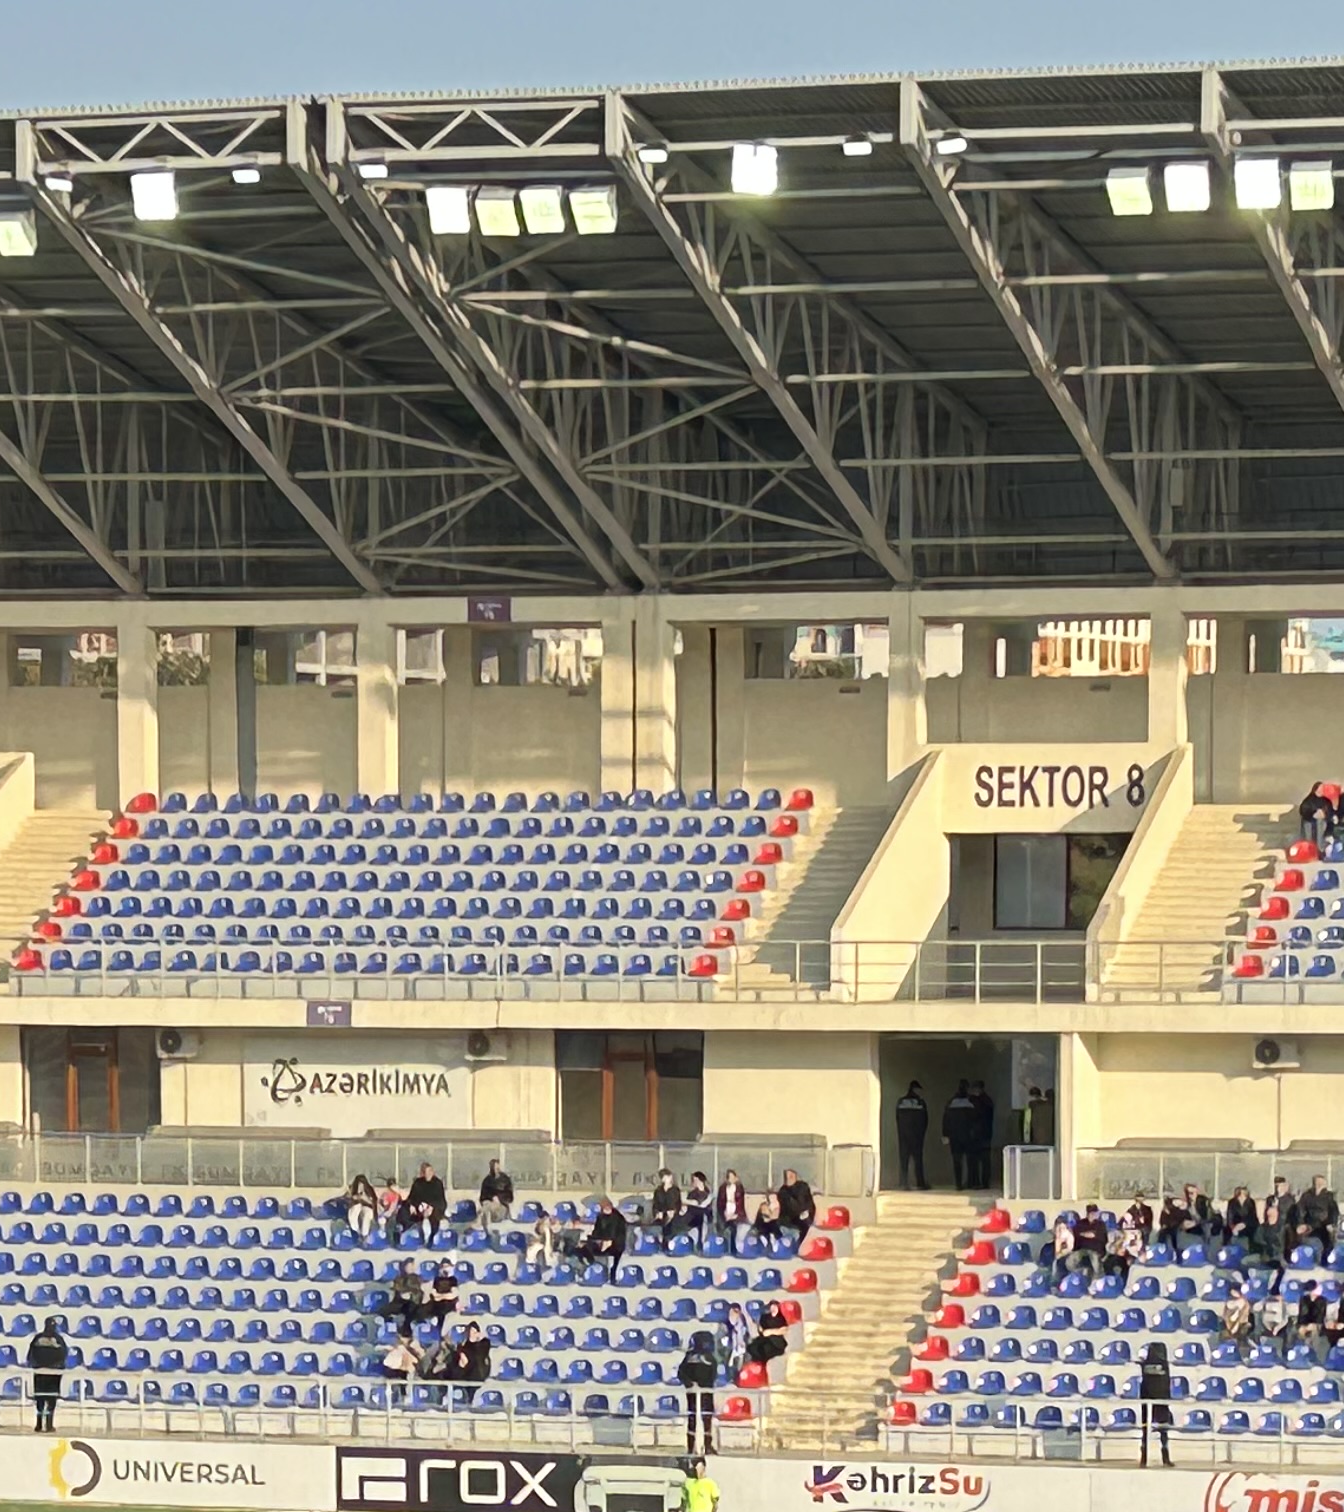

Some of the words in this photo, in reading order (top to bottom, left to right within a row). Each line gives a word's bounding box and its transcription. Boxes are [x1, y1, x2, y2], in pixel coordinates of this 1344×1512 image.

[974, 764, 1109, 809] SEKTOR
[1125, 763, 1146, 807] 8
[112, 1458, 266, 1486] UNIVERSAL
